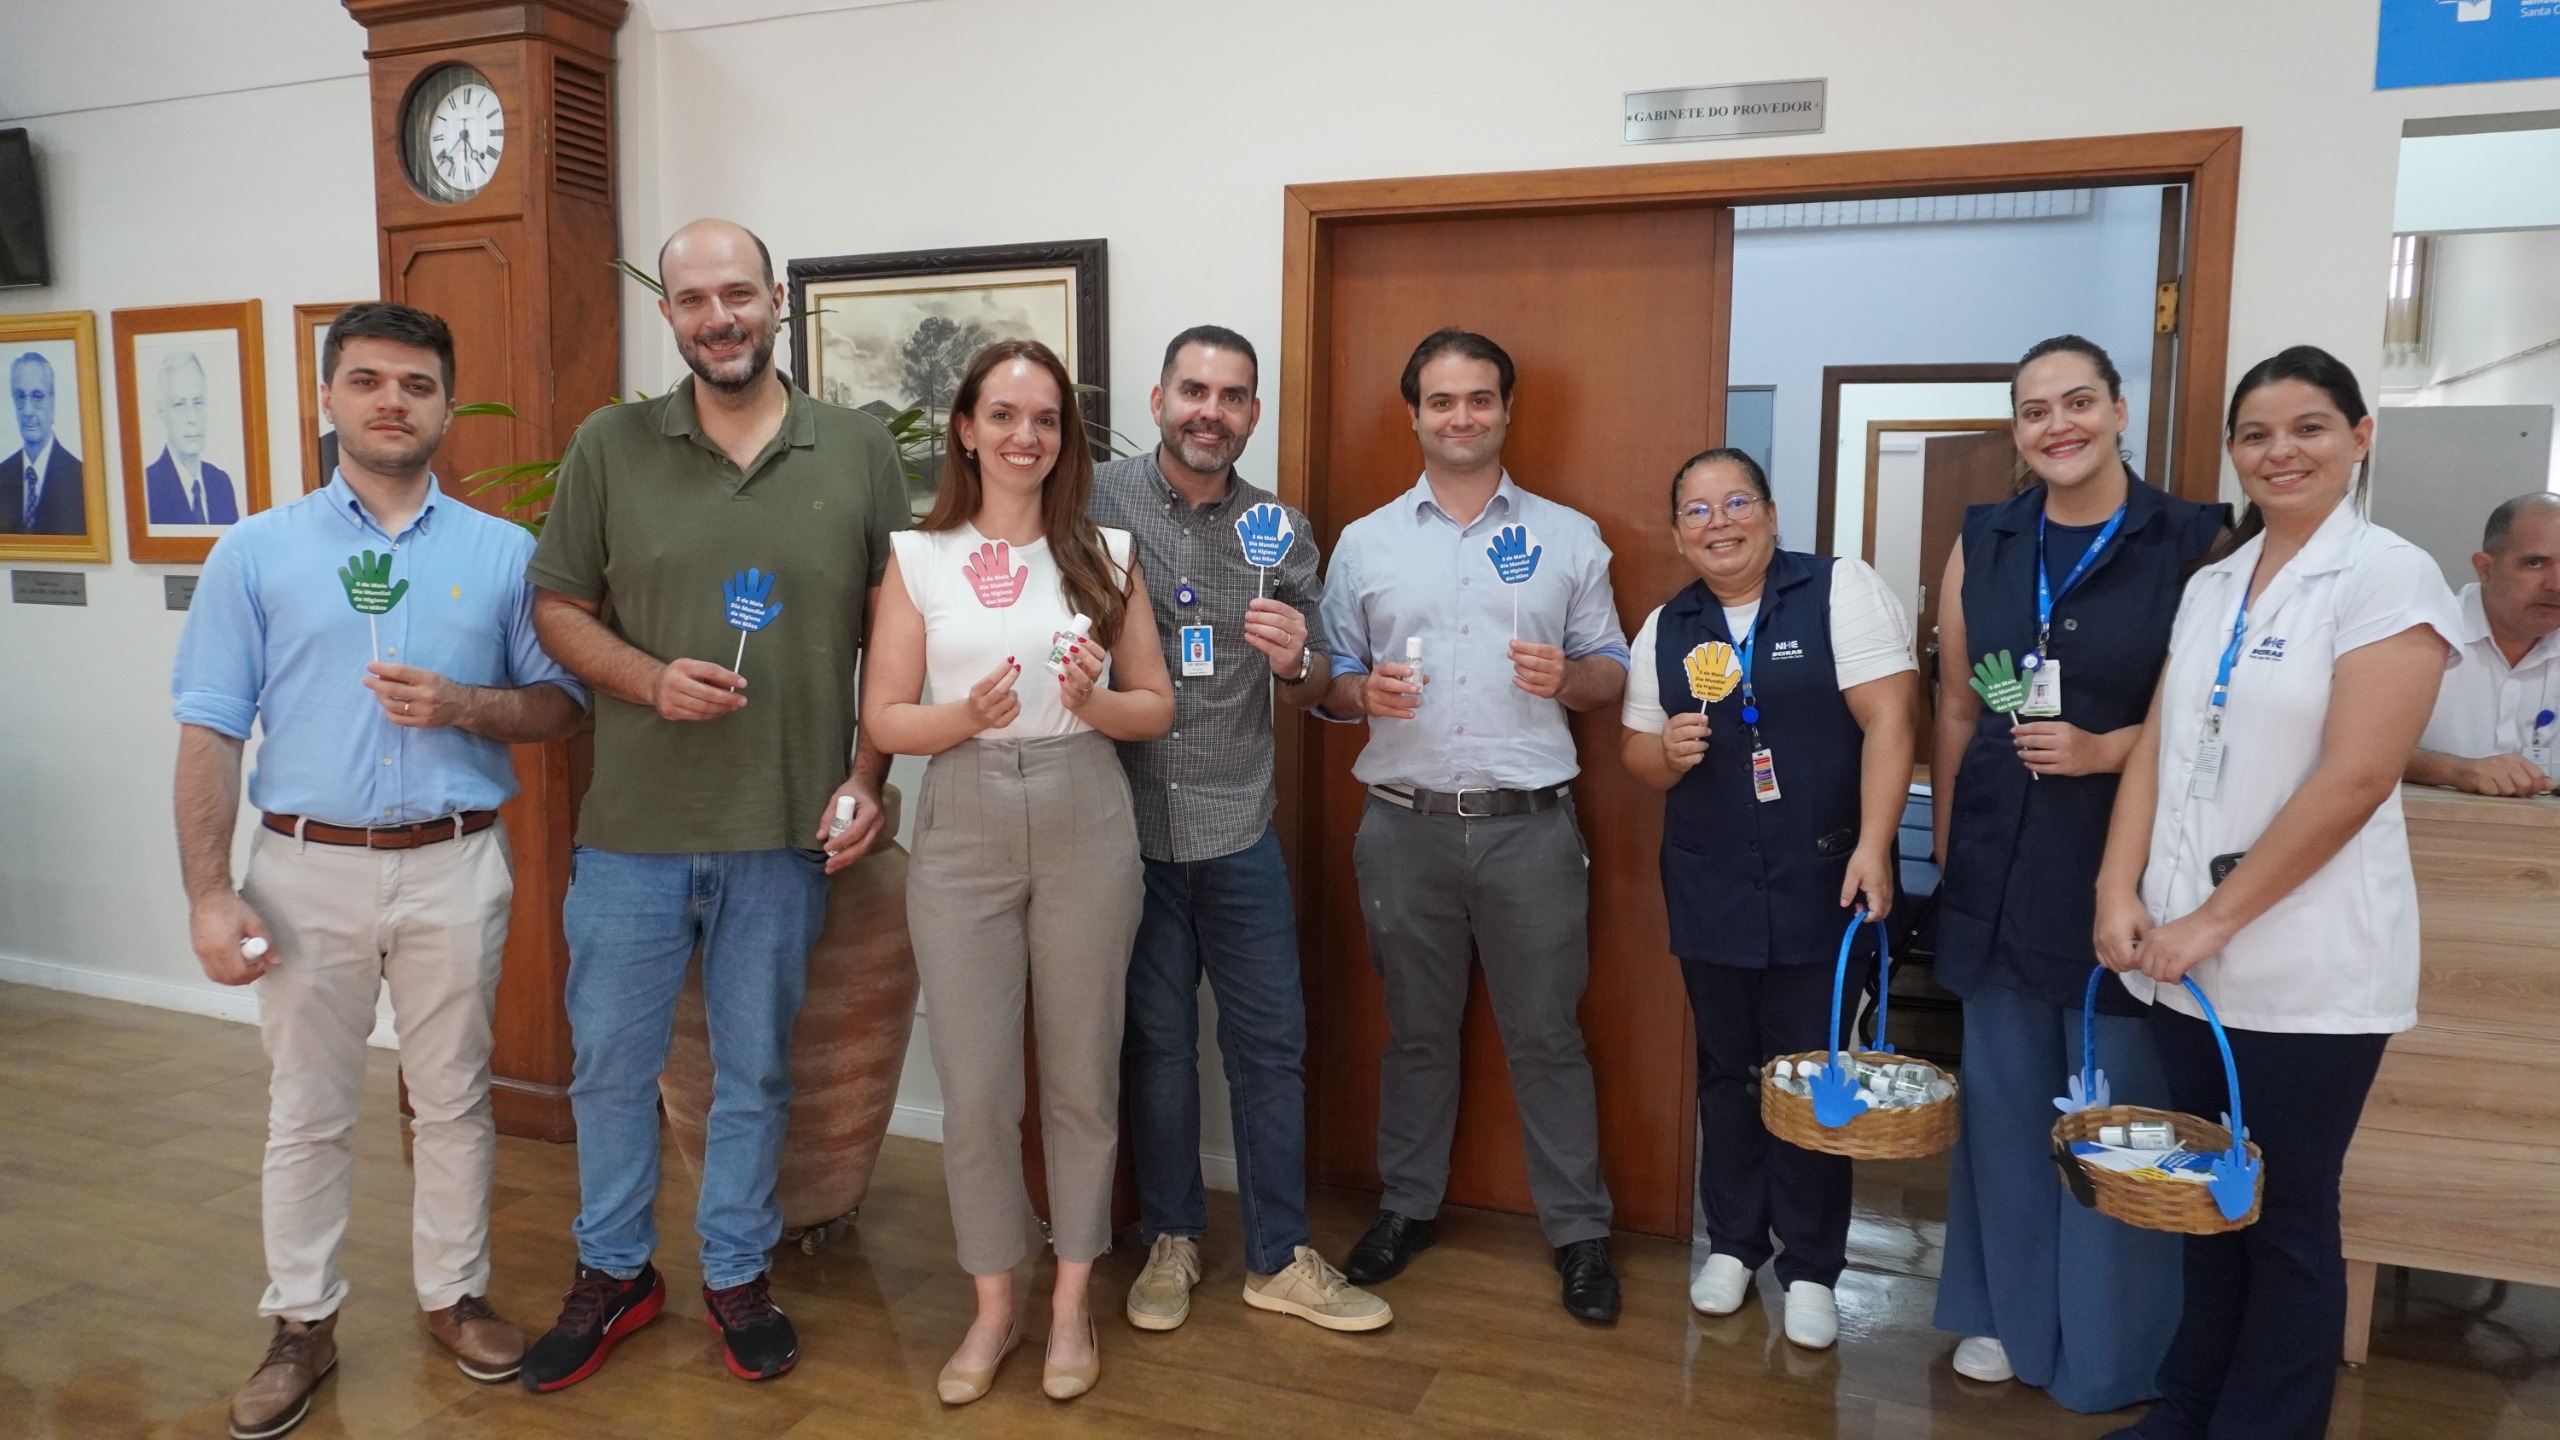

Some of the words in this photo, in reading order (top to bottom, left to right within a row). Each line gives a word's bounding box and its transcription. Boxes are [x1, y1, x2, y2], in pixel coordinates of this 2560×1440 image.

[2520, 6, 2551, 18] Santa
[1634, 107, 1704, 122] GABINETE
[1708, 106, 1728, 117] DO
[1733, 100, 1812, 115] PROVEDOR
[741, 606, 765, 616] Mundial
[1998, 684, 2022, 695] Mundial
[2000, 692, 2022, 703] Higiene
